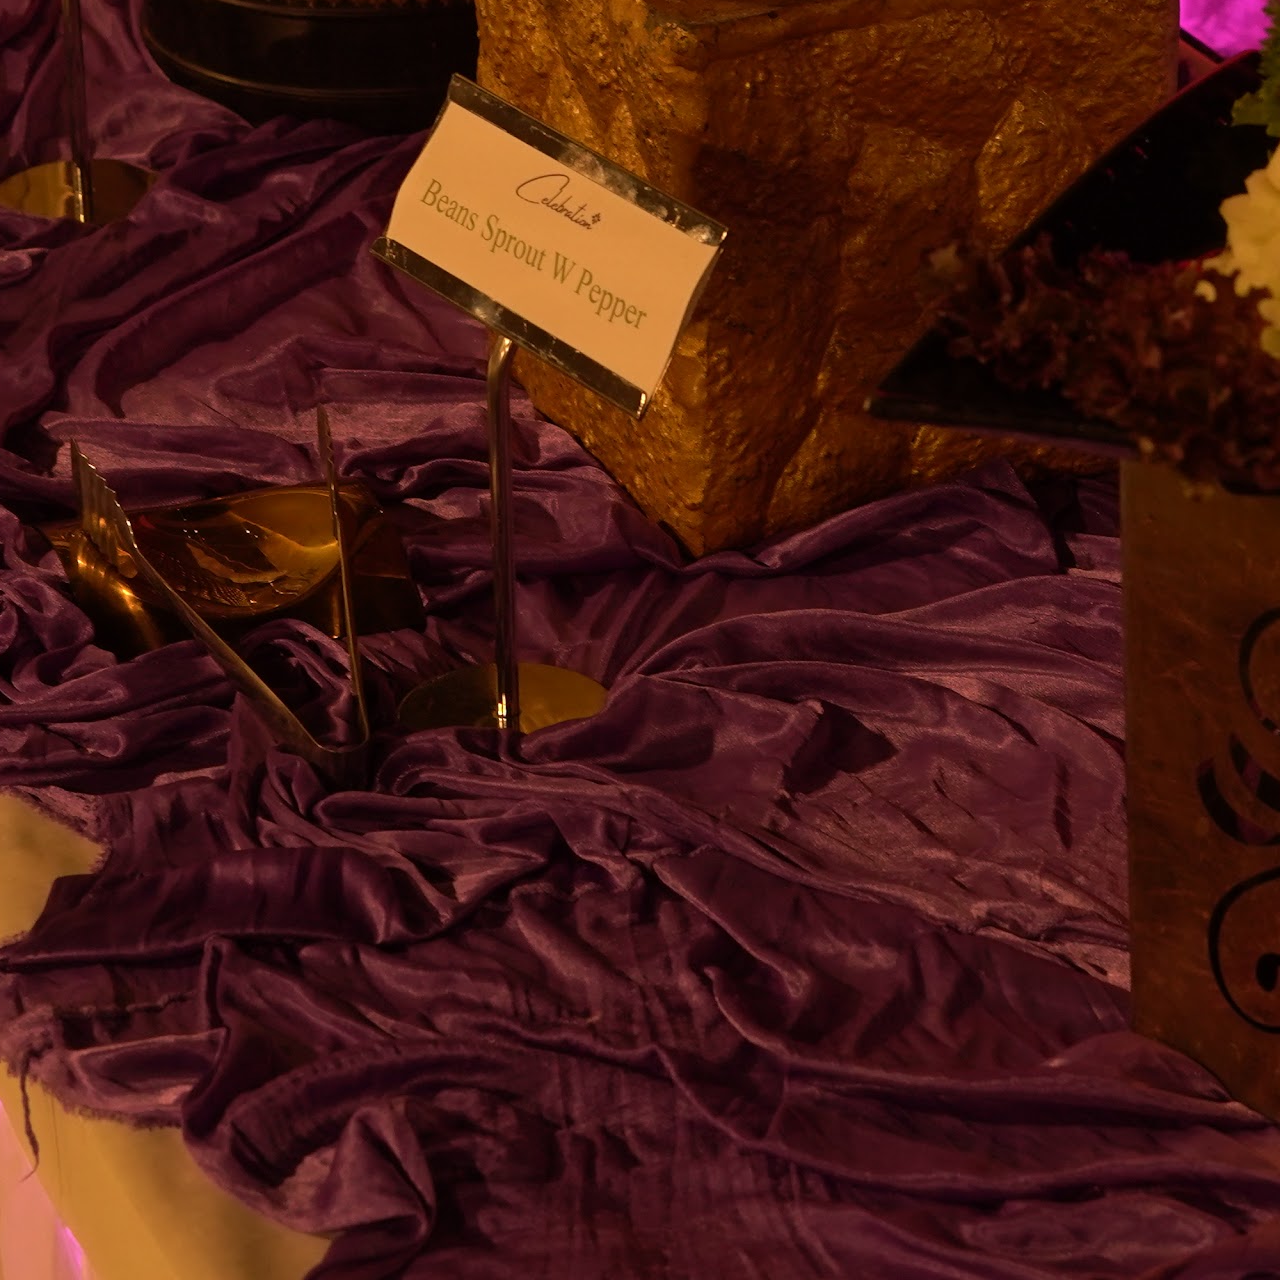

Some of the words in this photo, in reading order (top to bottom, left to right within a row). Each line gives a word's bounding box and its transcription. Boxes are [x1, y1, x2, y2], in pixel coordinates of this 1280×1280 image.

[420, 178, 480, 232] Beans
[480, 214, 548, 272] Sprout
[551, 251, 577, 285] W
[573, 267, 647, 330] Pepper
[516, 174, 593, 231] Celebration
